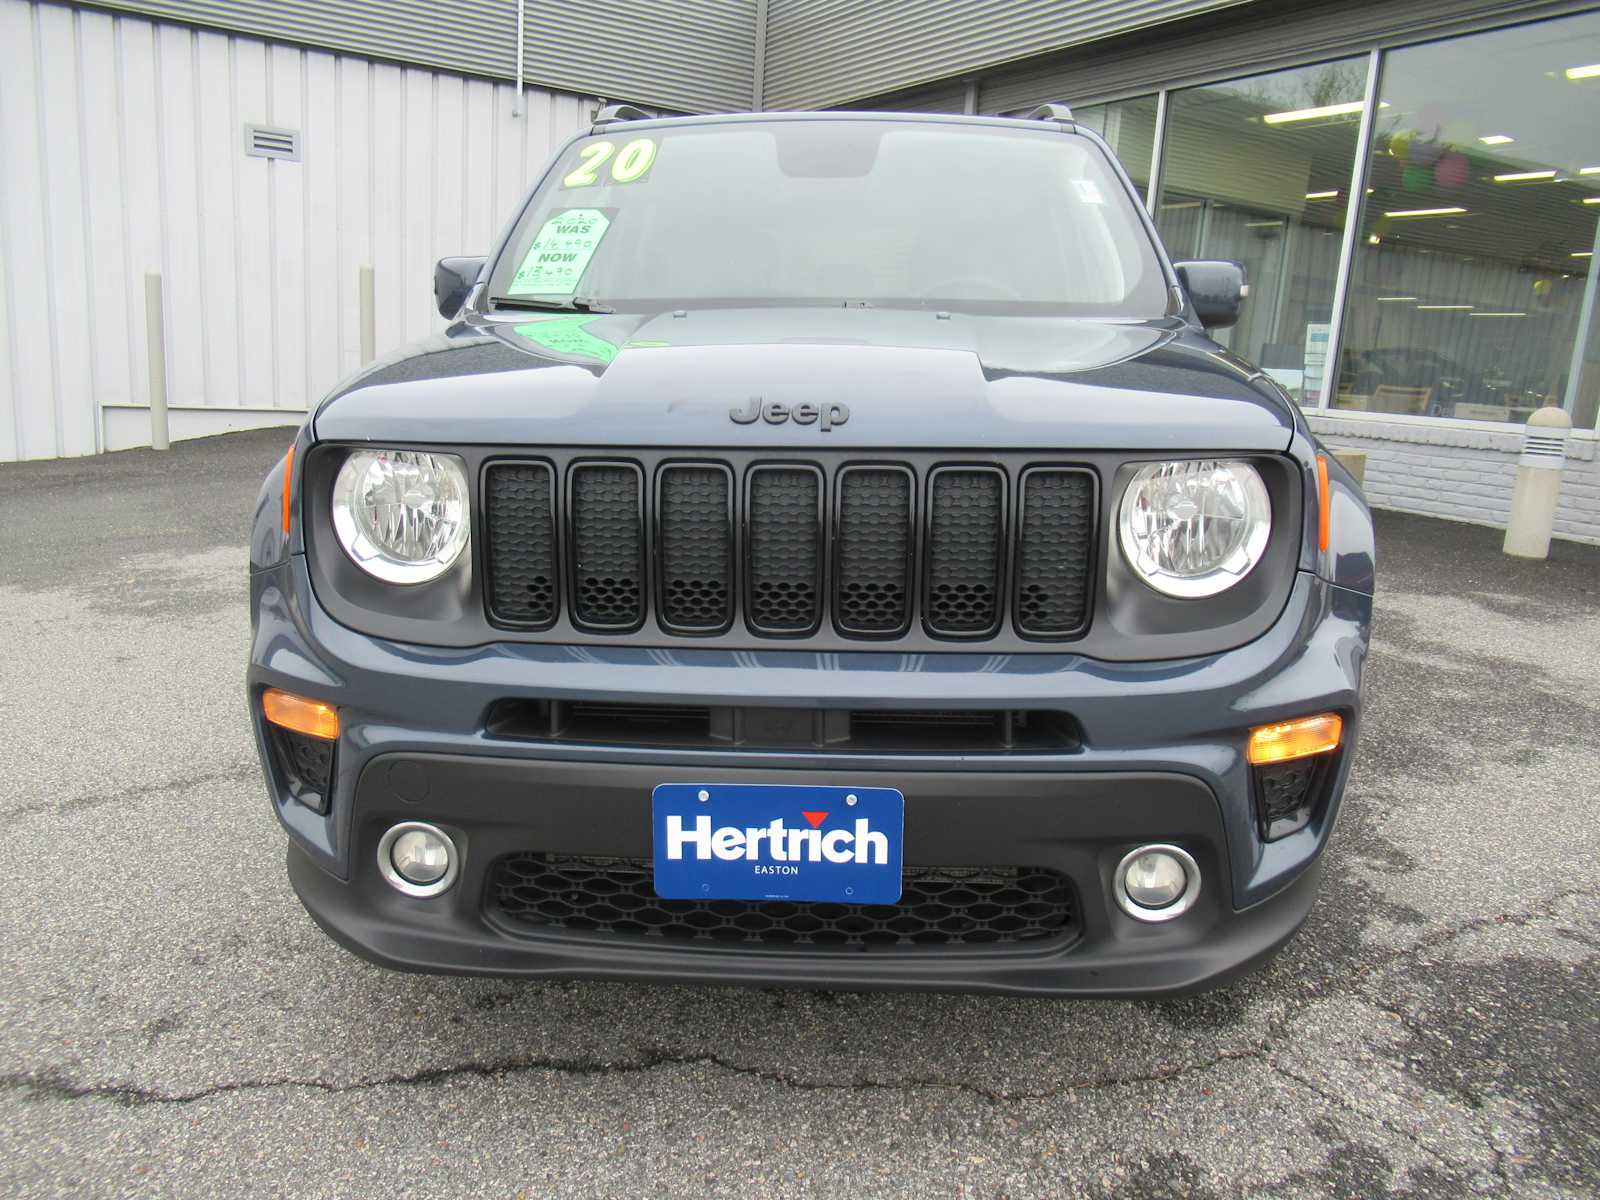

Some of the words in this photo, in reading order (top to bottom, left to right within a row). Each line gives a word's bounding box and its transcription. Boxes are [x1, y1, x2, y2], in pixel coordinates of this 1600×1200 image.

[563, 138, 657, 188] 20
[556, 224, 592, 234] WAS
[537, 252, 578, 262] NOW
[729, 395, 850, 432] Jeep
[666, 815, 889, 865] Hertrich
[754, 865, 799, 875] EASTON
